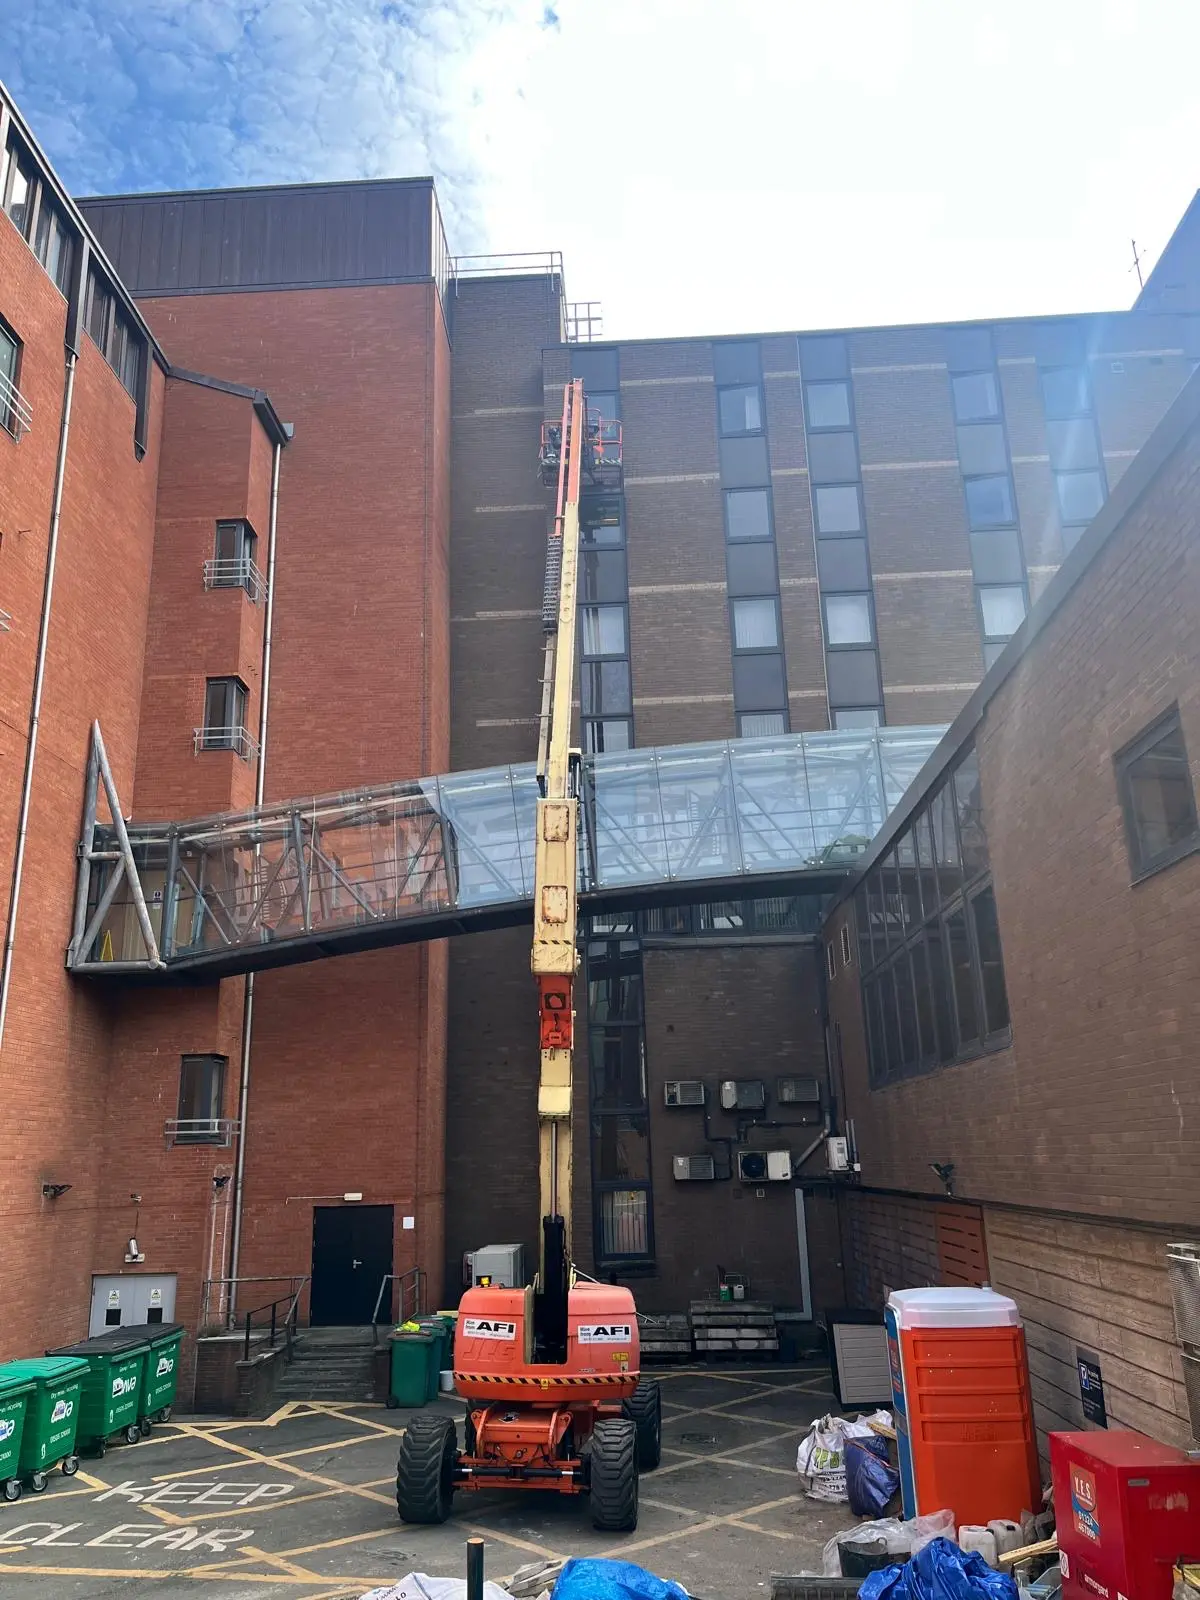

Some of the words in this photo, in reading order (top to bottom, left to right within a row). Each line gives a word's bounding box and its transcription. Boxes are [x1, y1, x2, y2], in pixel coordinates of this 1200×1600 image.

[477, 1321, 515, 1333] AFI
[593, 1326, 629, 1336] AFI
[92, 1480, 295, 1505] KEEP
[0, 1521, 255, 1552] CLEAR
